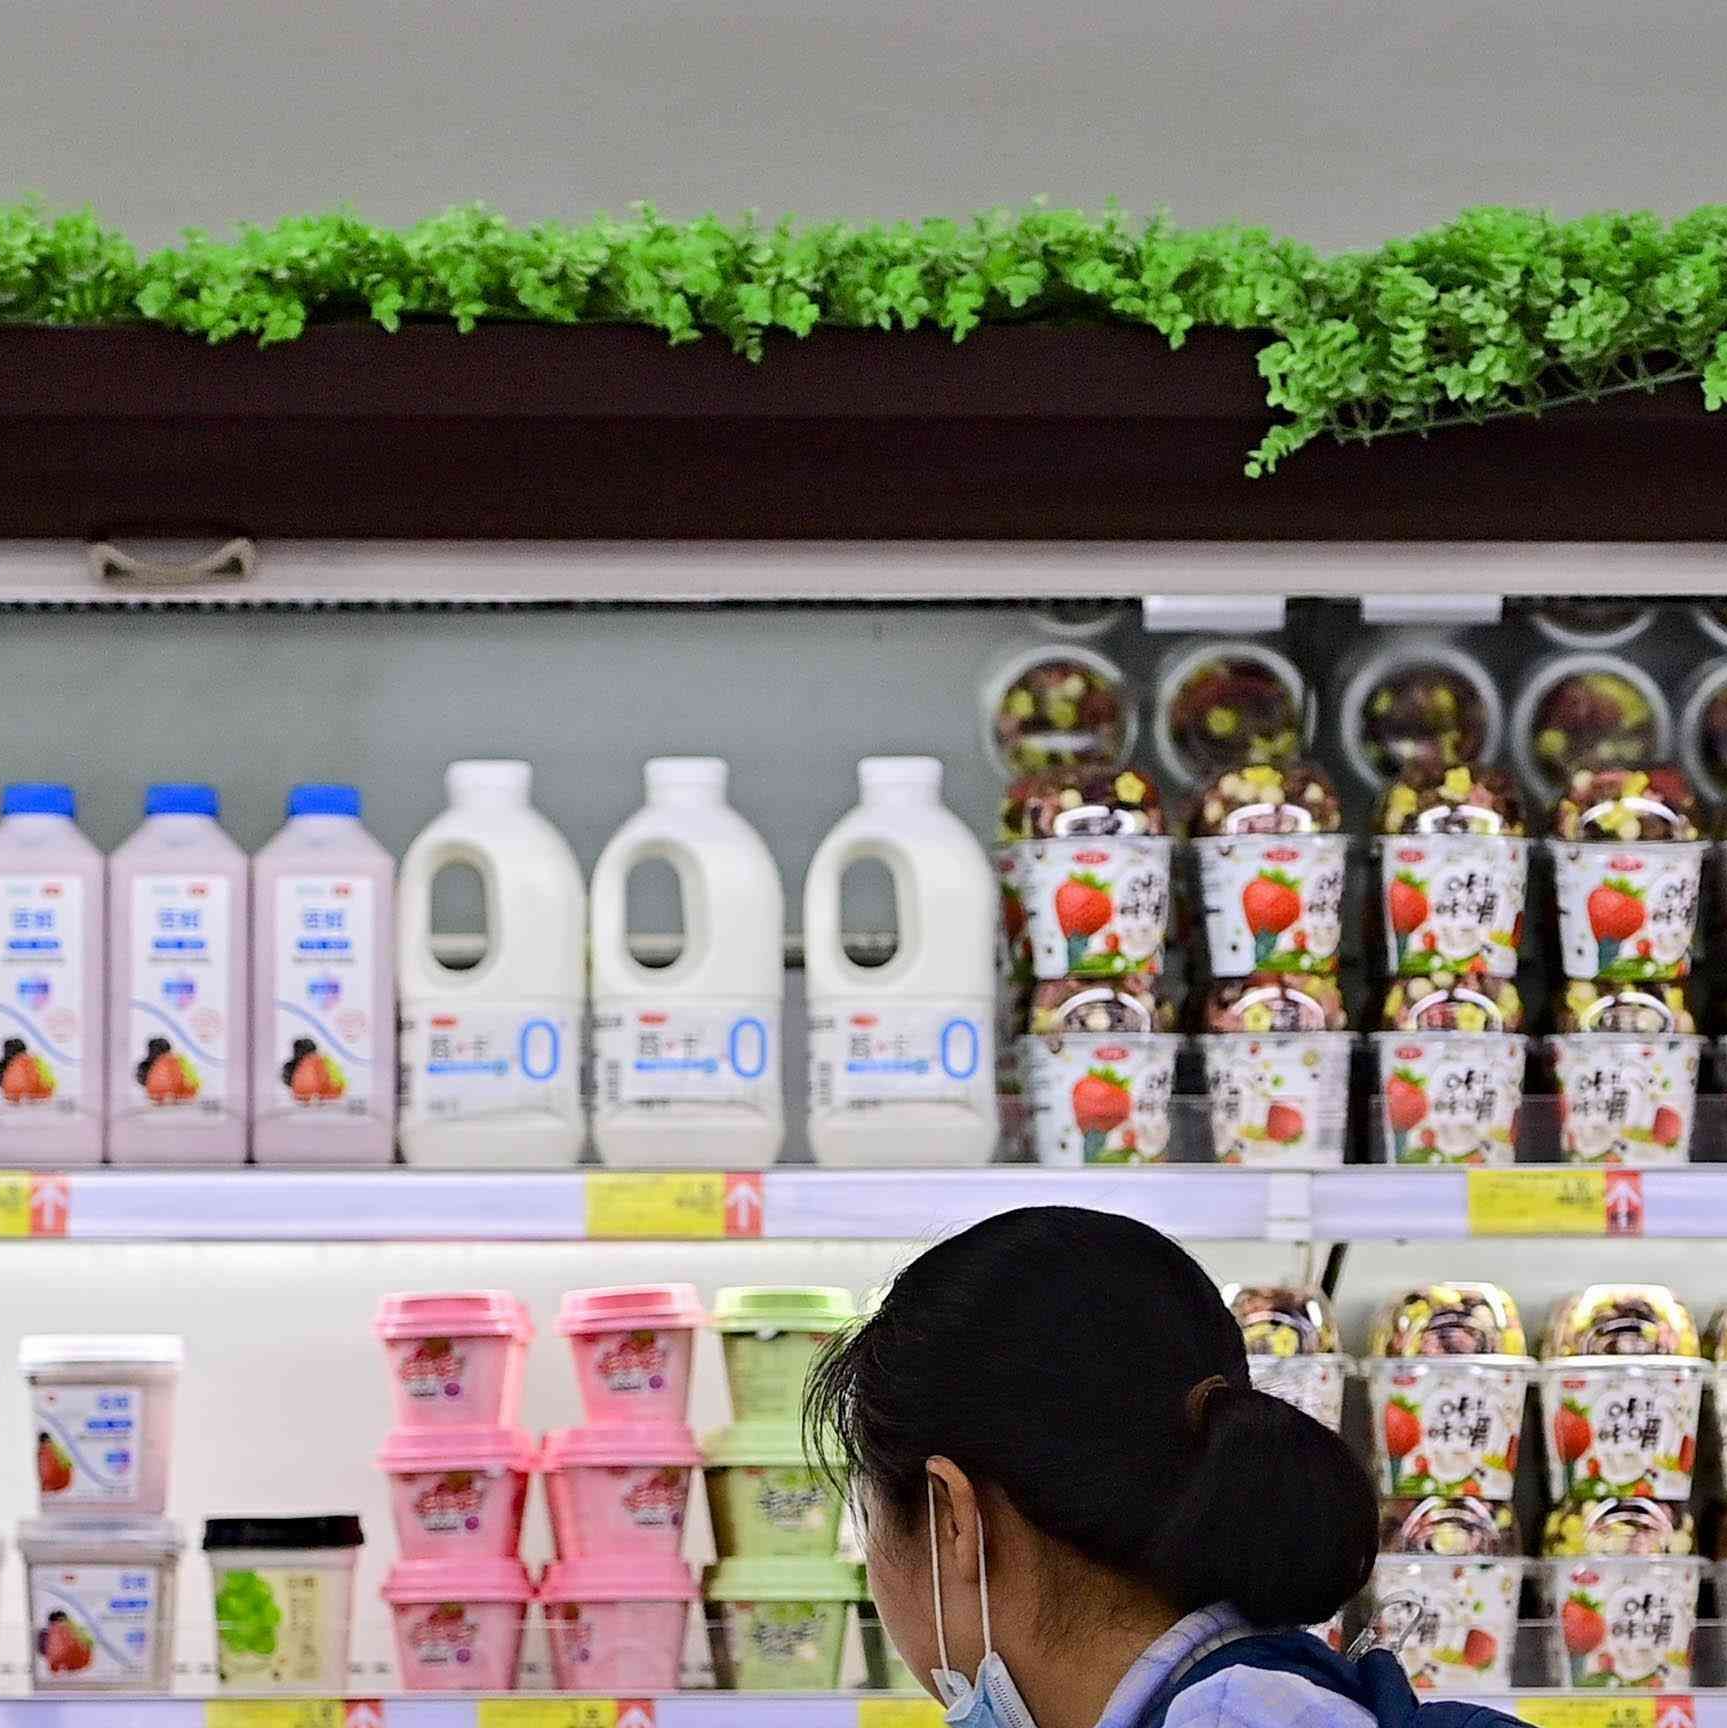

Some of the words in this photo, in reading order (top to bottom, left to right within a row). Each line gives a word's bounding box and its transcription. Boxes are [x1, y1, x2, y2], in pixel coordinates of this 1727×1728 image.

[522, 1019, 558, 1080] 0
[731, 1016, 768, 1078] 0
[941, 1016, 978, 1079] 0
